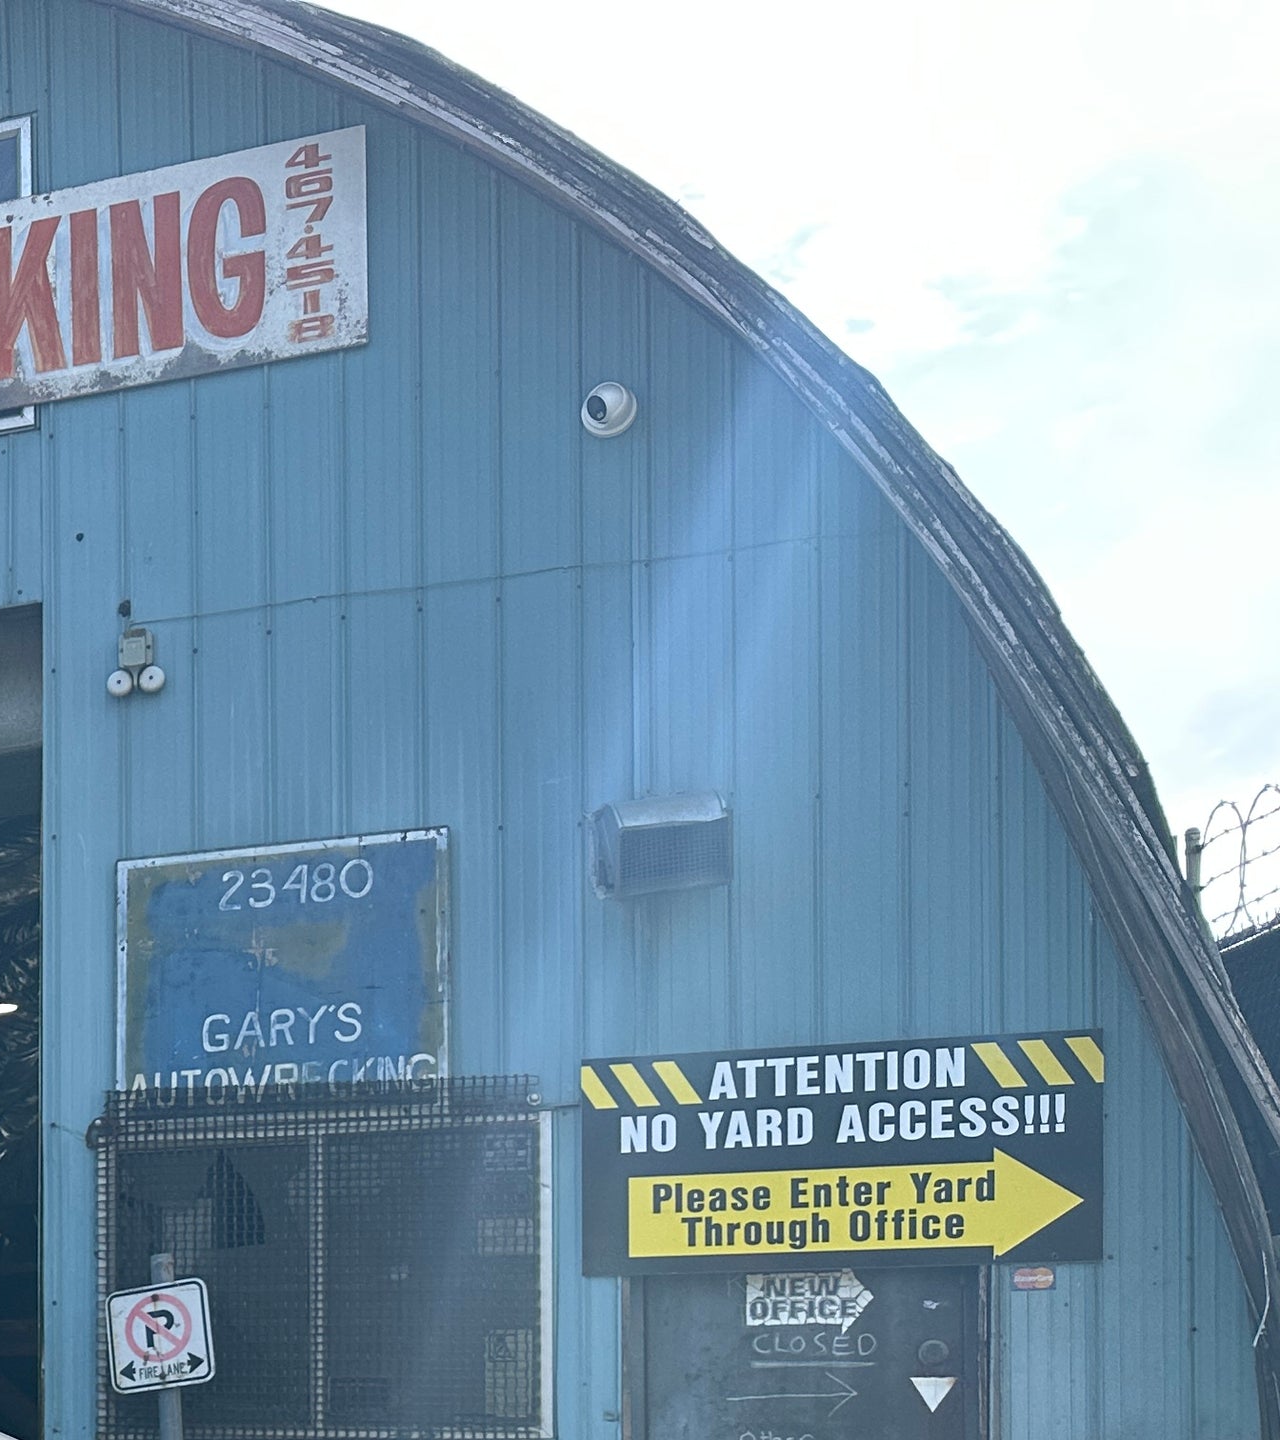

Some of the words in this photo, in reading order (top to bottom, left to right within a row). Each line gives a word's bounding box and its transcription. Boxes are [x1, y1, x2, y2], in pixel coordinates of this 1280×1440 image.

[217, 857, 375, 913] 23480
[201, 1001, 365, 1053] GARY'S
[128, 1053, 437, 1109] AUTOWRECKING
[708, 1046, 967, 1101] ATTENTION
[620, 1112, 678, 1154] NO
[697, 1107, 814, 1150] YARD
[835, 1092, 1067, 1144] ACCESS!!!
[651, 1180, 771, 1214] Please
[790, 1175, 892, 1209] Enter
[906, 1169, 996, 1205] Yard
[681, 1213, 831, 1250] Through
[848, 1208, 965, 1242] Office
[761, 1275, 841, 1297] NEW
[749, 1297, 858, 1321] OFFICE
[752, 1331, 877, 1356] CLOSED
[138, 1365, 159, 1380] FIRE
[160, 1361, 188, 1377] LANE
